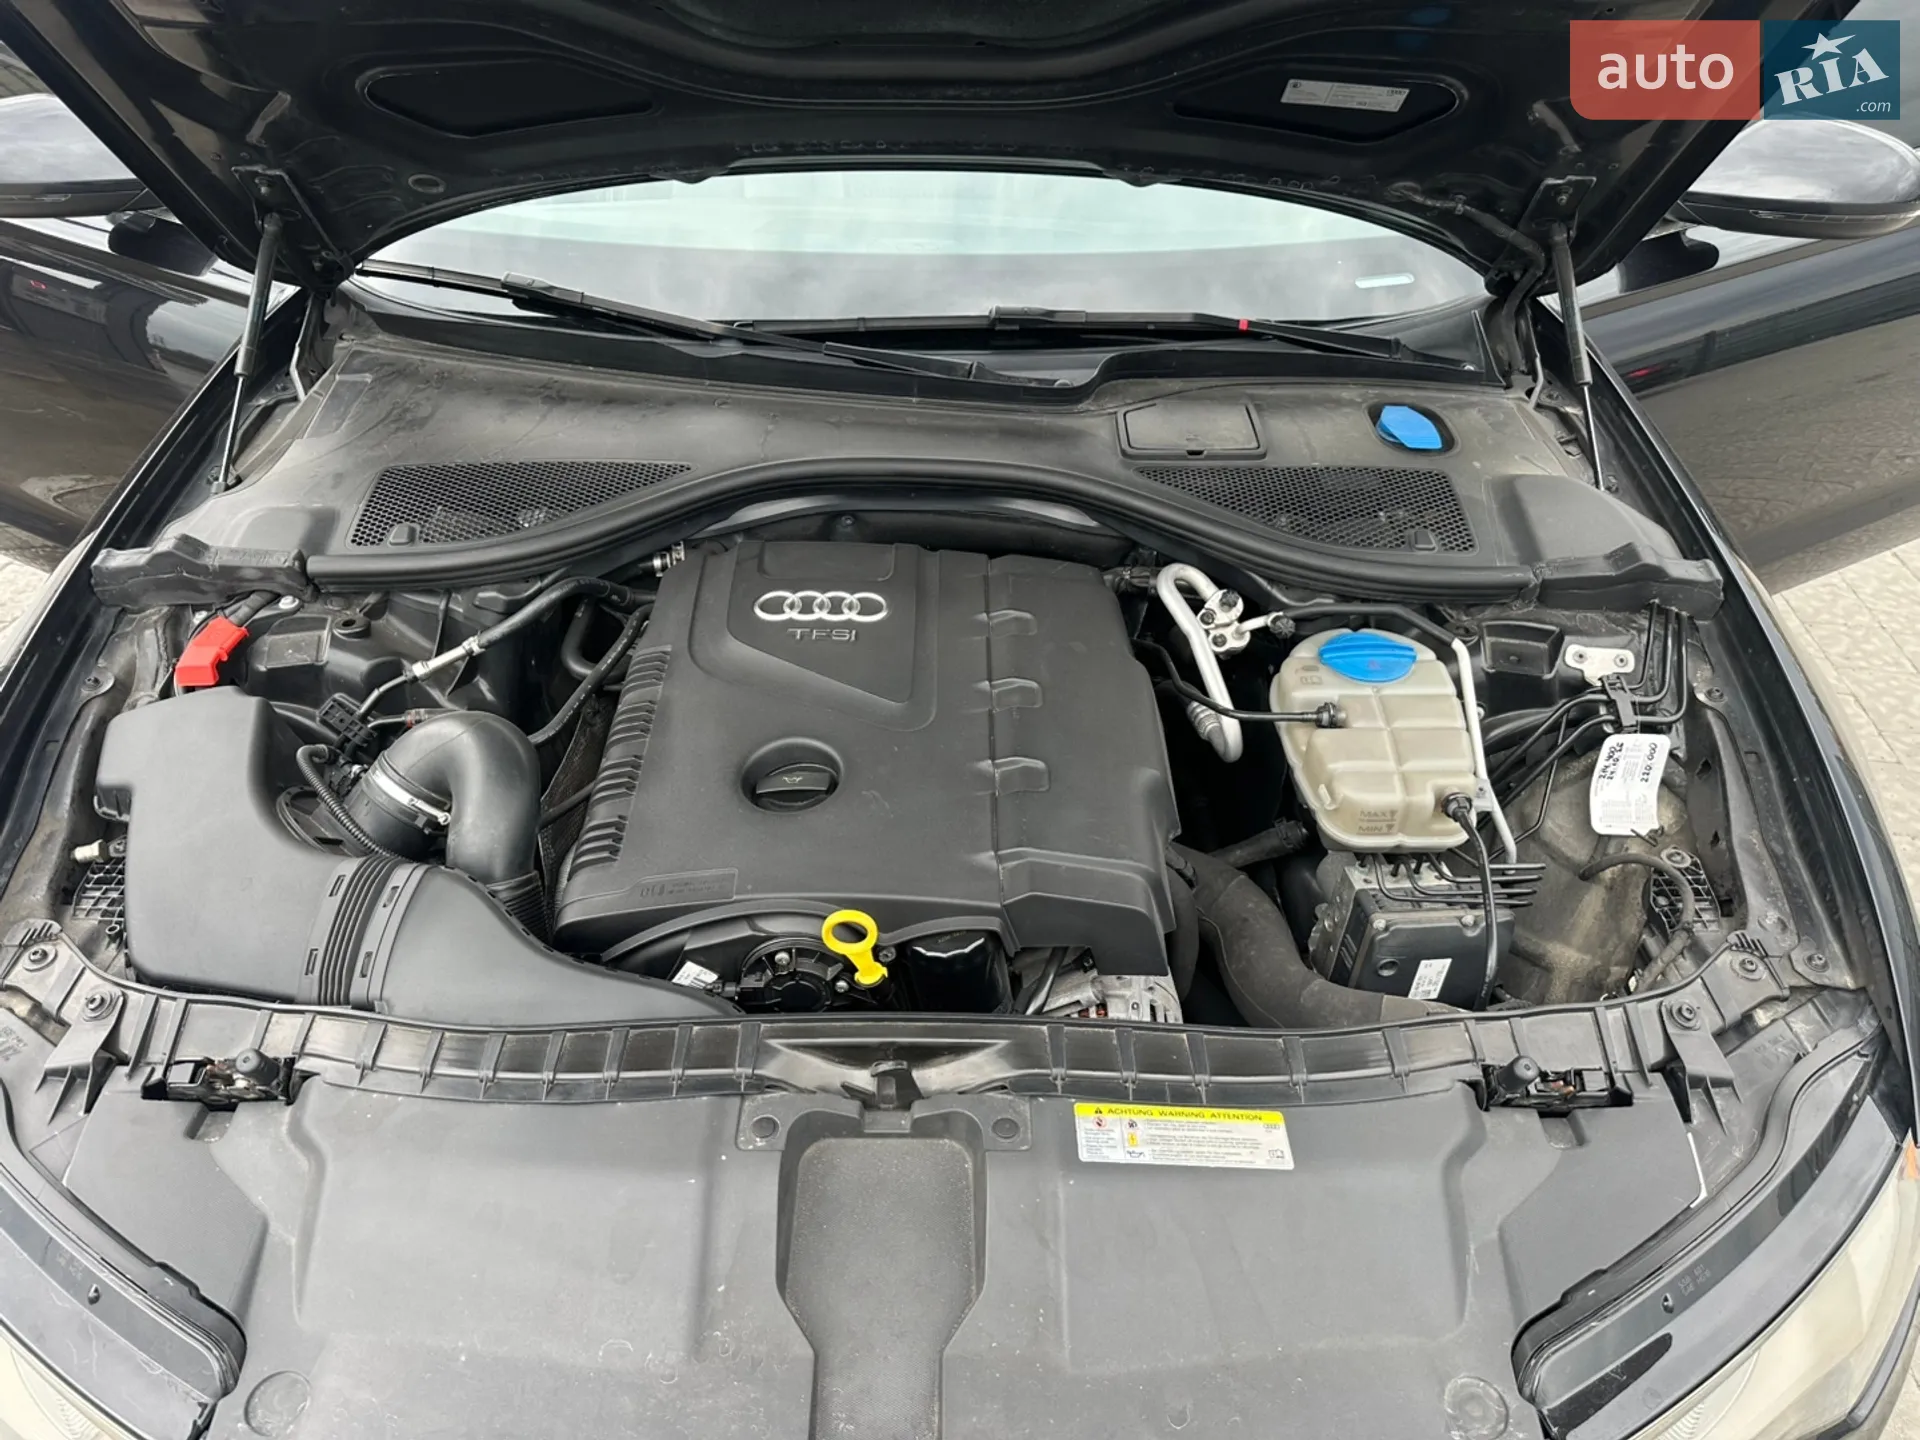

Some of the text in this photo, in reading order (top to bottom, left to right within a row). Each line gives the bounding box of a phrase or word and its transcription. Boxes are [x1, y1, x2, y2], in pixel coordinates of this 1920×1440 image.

[786, 627, 857, 641] TFSI
[1360, 810, 1388, 818] MAX
[1358, 825, 1383, 833] MIN
[1107, 1107, 1262, 1121] ACHTUNG WARNING ATTENTION
